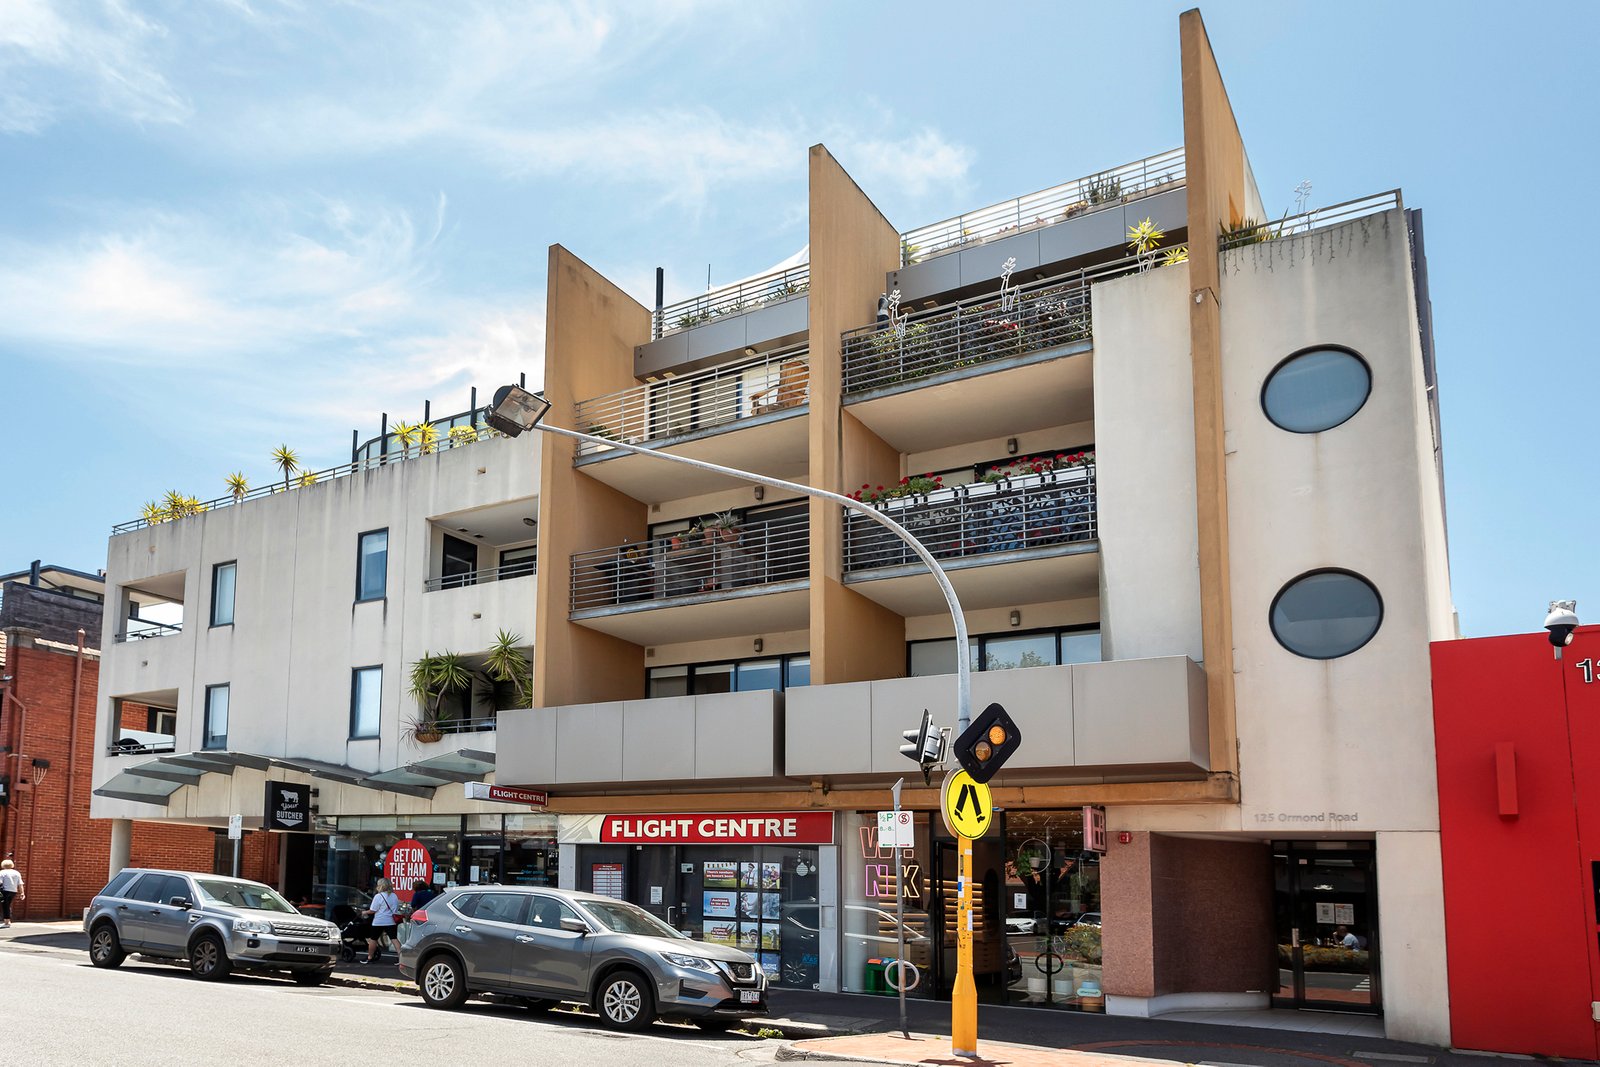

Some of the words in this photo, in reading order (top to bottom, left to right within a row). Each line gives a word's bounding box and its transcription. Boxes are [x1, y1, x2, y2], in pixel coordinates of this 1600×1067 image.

[493, 789, 518, 799] FLIGHT
[518, 793, 545, 803] CENTRE
[276, 810, 304, 820] BUTCHER
[1253, 813, 1275, 823] 125
[1278, 812, 1325, 822] Ormond
[1328, 811, 1358, 822] Road
[611, 819, 694, 838] FLIGHT
[698, 818, 797, 837] CENTRE
[393, 848, 410, 863] GET
[411, 848, 424, 863] ON
[389, 862, 406, 877] THE
[407, 862, 427, 877] HAM
